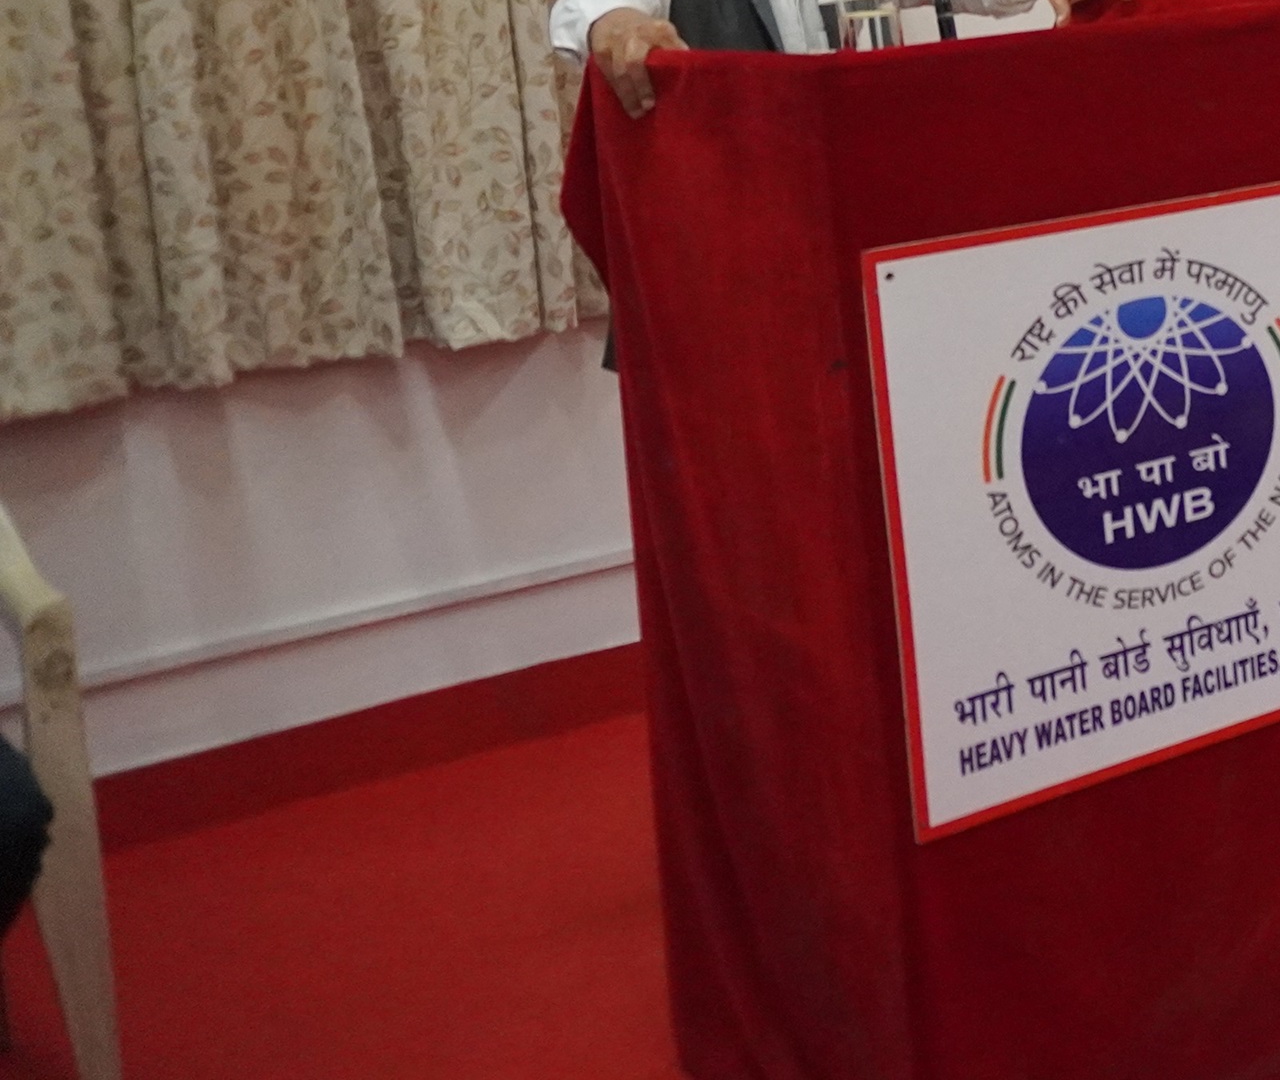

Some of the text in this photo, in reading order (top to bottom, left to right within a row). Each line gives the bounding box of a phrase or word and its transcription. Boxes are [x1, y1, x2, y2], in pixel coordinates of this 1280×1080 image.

[1011, 247, 1268, 362] राष्ट्र की सेवा में परमाणु
[1077, 433, 1230, 499] भा पा बो
[987, 491, 1042, 569] ATOMS
[1036, 562, 1064, 589] IN
[1065, 575, 1107, 608] THE
[1113, 571, 1205, 610] SERVICE
[1208, 550, 1237, 580] OF
[1237, 508, 1276, 551] THE
[1102, 487, 1215, 545] HWB
[954, 671, 1015, 726] भारी
[1028, 649, 1087, 703] पानी
[1100, 628, 1151, 680] बोर्ड
[959, 731, 1028, 775] HEAVY
[1034, 705, 1104, 752] WATER
[1110, 678, 1175, 726] BOARD
